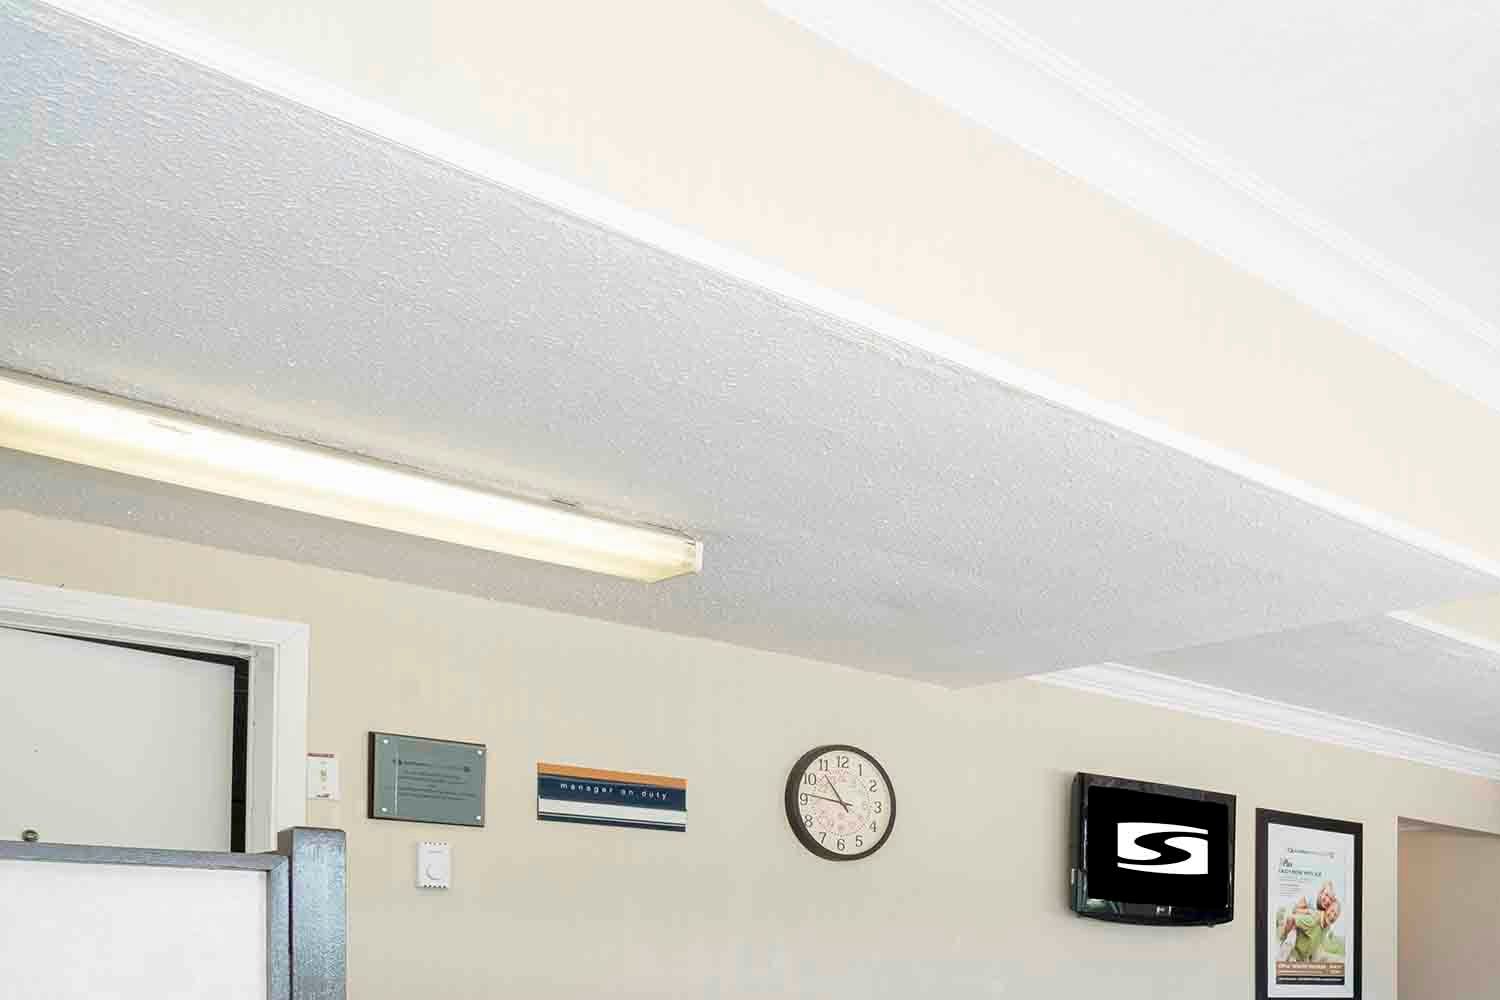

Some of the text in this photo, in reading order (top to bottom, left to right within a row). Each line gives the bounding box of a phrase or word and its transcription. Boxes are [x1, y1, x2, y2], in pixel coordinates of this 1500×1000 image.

[818, 759, 829, 772] 11
[836, 756, 849, 769] 12
[858, 764, 862, 776] 1
[803, 773, 817, 786] 10
[869, 780, 878, 792] 2
[560, 783, 669, 800] manager on duty
[800, 792, 808, 806] 9
[874, 800, 882, 814] 3
[804, 814, 813, 828] 8
[870, 820, 877, 833] 4
[818, 832, 827, 844] 7
[836, 838, 846, 851] 6
[856, 835, 864, 848] 5
